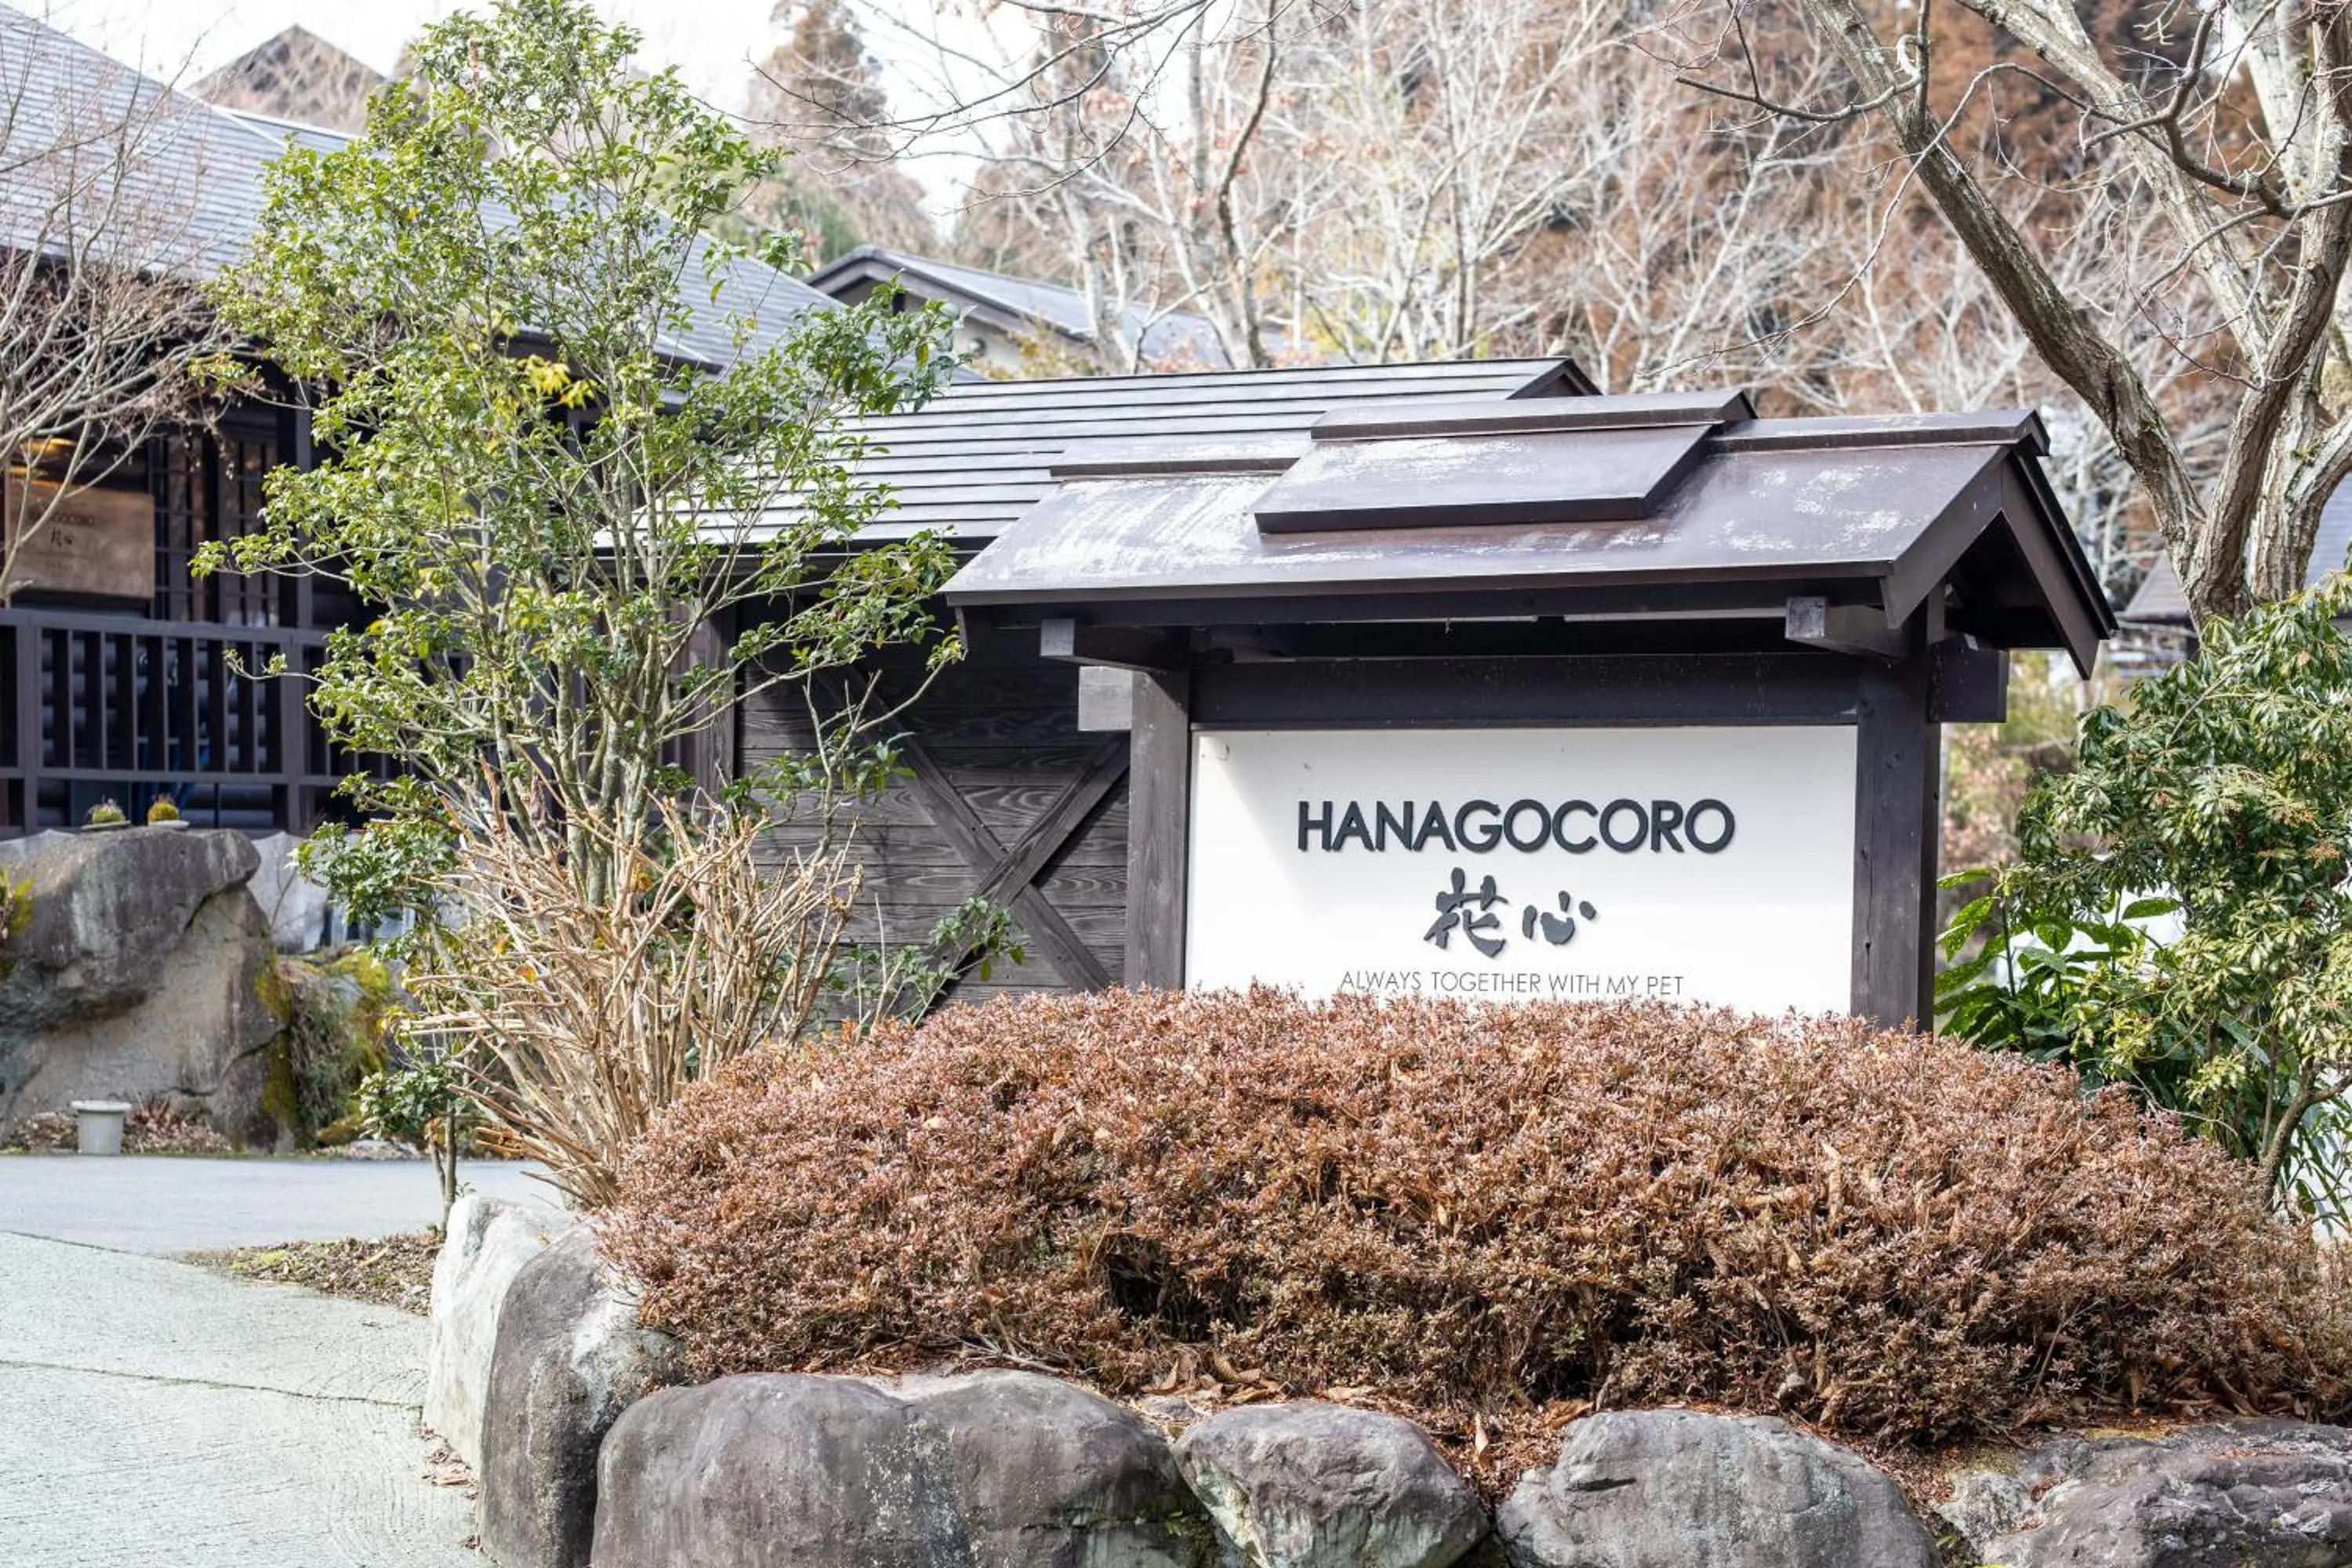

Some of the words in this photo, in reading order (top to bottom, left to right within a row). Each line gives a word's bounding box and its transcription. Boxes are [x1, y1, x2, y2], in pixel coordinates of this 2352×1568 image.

[1298, 799, 1735, 854] HANAGOCORO
[1424, 867, 1597, 958] 花心
[1340, 971, 1421, 990] ALWAYS
[1431, 971, 1541, 993] TOGETHER
[1548, 973, 1600, 994] WITH
[1606, 975, 1639, 994] MY
[1647, 976, 1684, 996] PET
